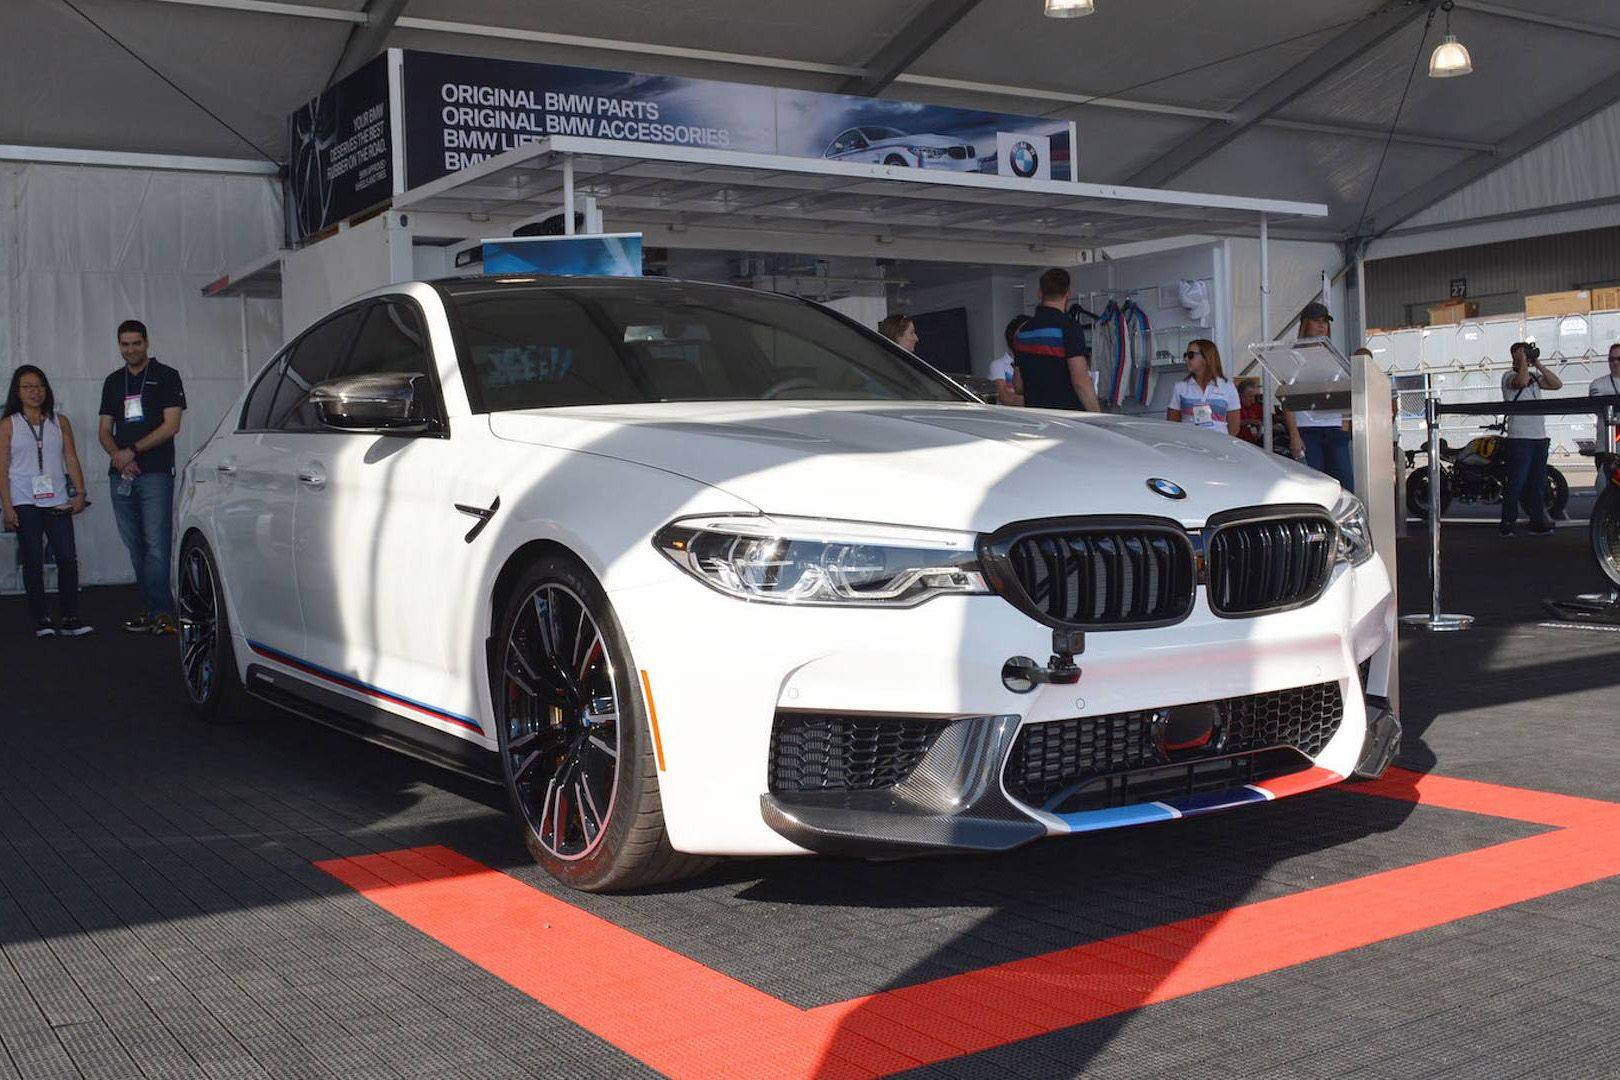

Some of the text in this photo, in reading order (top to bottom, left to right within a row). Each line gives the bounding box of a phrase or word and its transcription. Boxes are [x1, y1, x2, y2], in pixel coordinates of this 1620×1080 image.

[441, 83, 659, 120] ORIGINAL BMW PARTS
[442, 106, 730, 146] ORIGINAL BMW ACCESSORIES
[444, 129, 498, 150] BMW
[1451, 285, 1466, 297] 27
